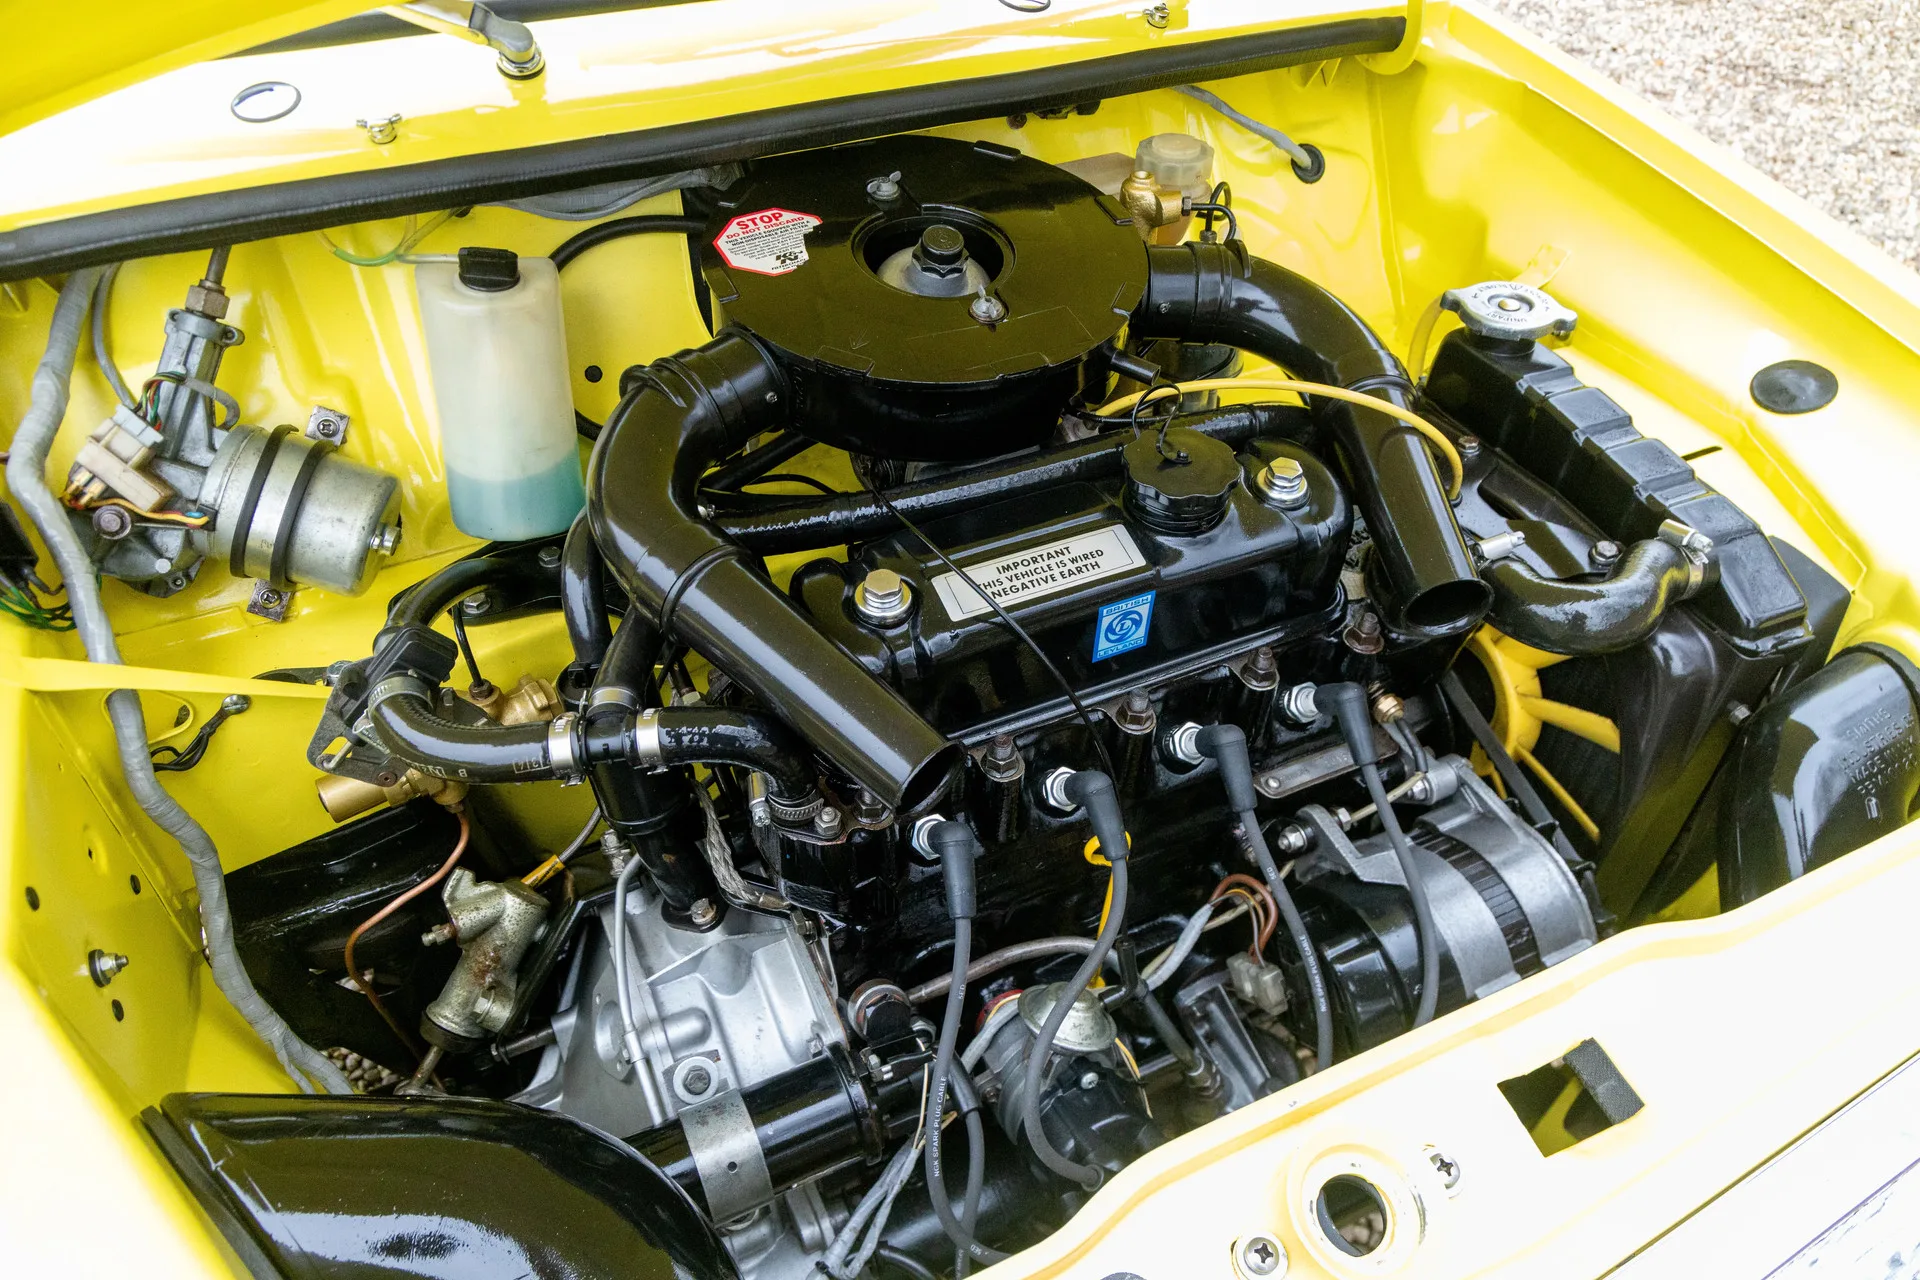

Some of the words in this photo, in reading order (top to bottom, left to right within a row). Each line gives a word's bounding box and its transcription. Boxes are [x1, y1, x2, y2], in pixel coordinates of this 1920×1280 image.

[736, 212, 783, 230] STOP
[742, 227, 760, 235] NOT
[764, 216, 804, 230] DISCARD
[996, 546, 1073, 574] IMPORTANT
[1005, 565, 1054, 582] VEHICLE
[1056, 560, 1066, 570] IS
[1068, 549, 1104, 566] WIRED
[990, 574, 1058, 600] NEGATIVE
[1061, 561, 1102, 580] EARTH
[1106, 597, 1149, 614] BRITISH
[1098, 639, 1143, 657] LEYLAND
[936, 1076, 947, 1102] CABLE
[934, 1105, 942, 1128] PLUG
